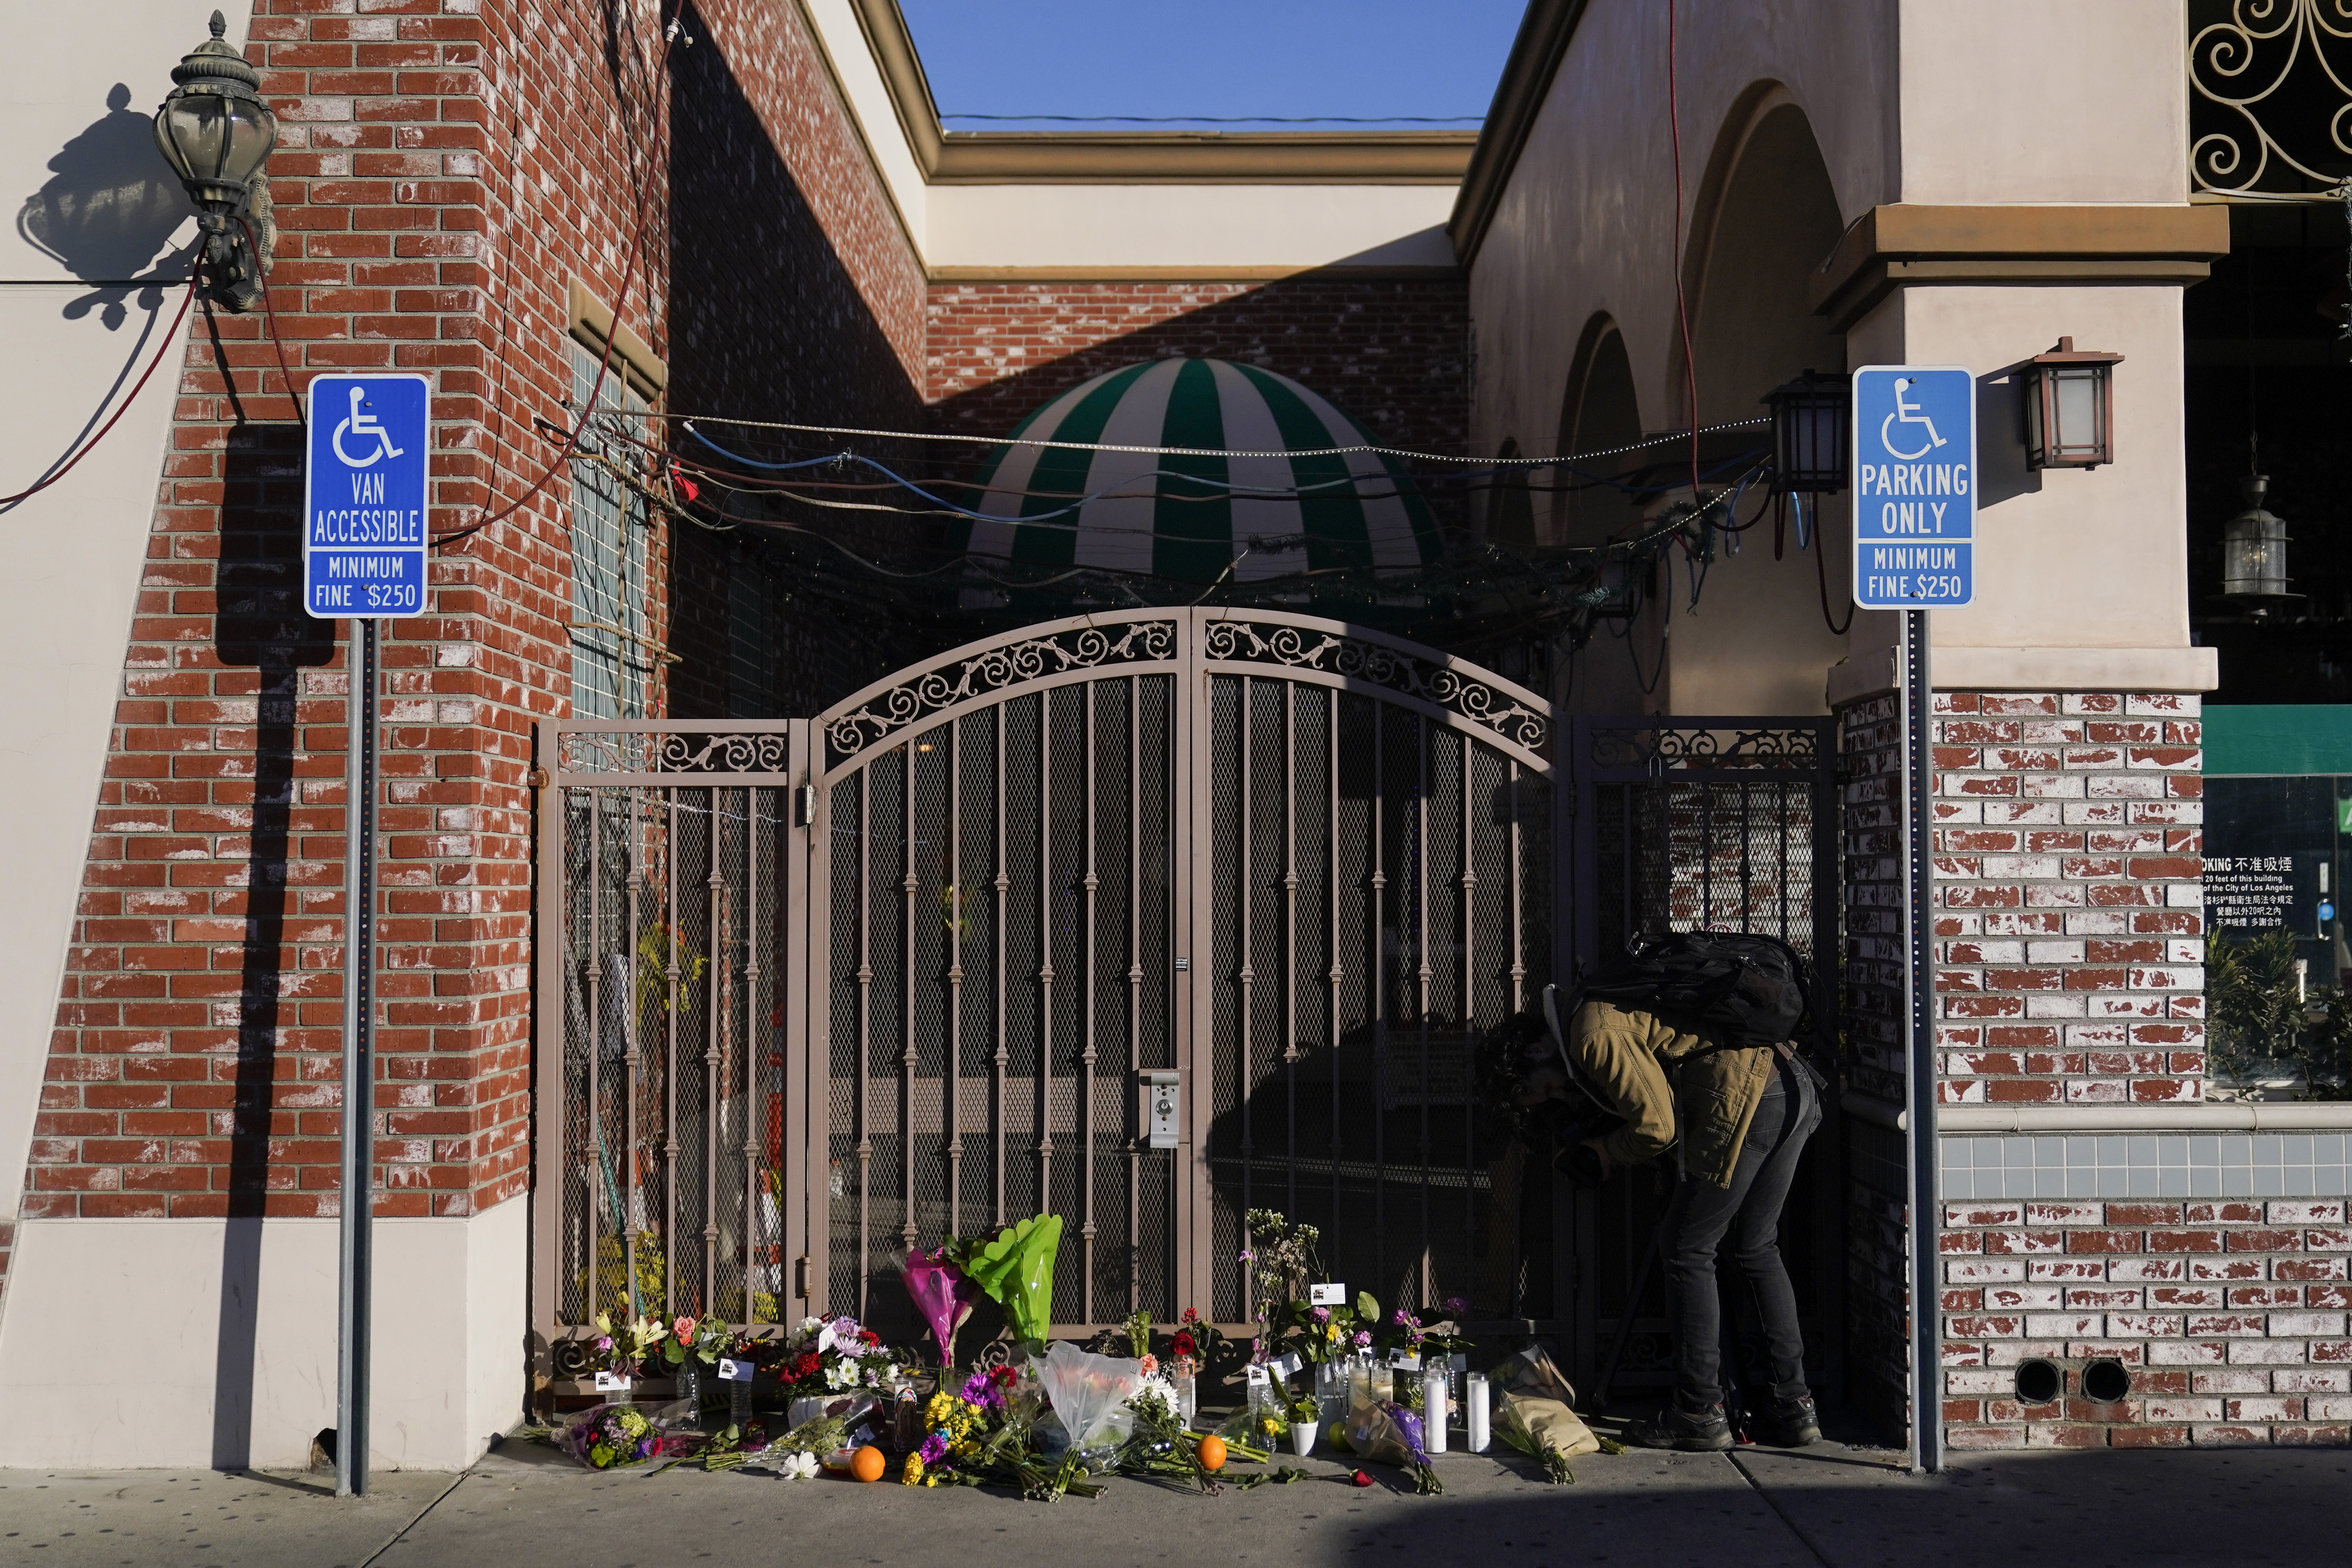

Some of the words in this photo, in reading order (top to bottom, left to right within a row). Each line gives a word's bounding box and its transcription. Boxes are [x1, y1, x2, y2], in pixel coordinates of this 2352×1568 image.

[352, 473, 384, 505] VAN
[1862, 463, 1967, 495] PARKING
[314, 510, 418, 542] ACCESSIBLE
[1882, 502, 1947, 534] ONLY
[329, 557, 403, 578] MINIMUM
[1874, 548, 1955, 570] MINIMUM
[316, 585, 352, 606] FINE
[368, 583, 415, 608] $250
[1869, 576, 1909, 598] FINE
[1917, 574, 1961, 600] $250
[2235, 857, 2292, 871] 不准吸煙
[2225, 884, 2239, 893] City
[2265, 884, 2293, 893] Angeles
[2254, 875, 2283, 883] building
[2251, 917, 2282, 927] 多謝合作
